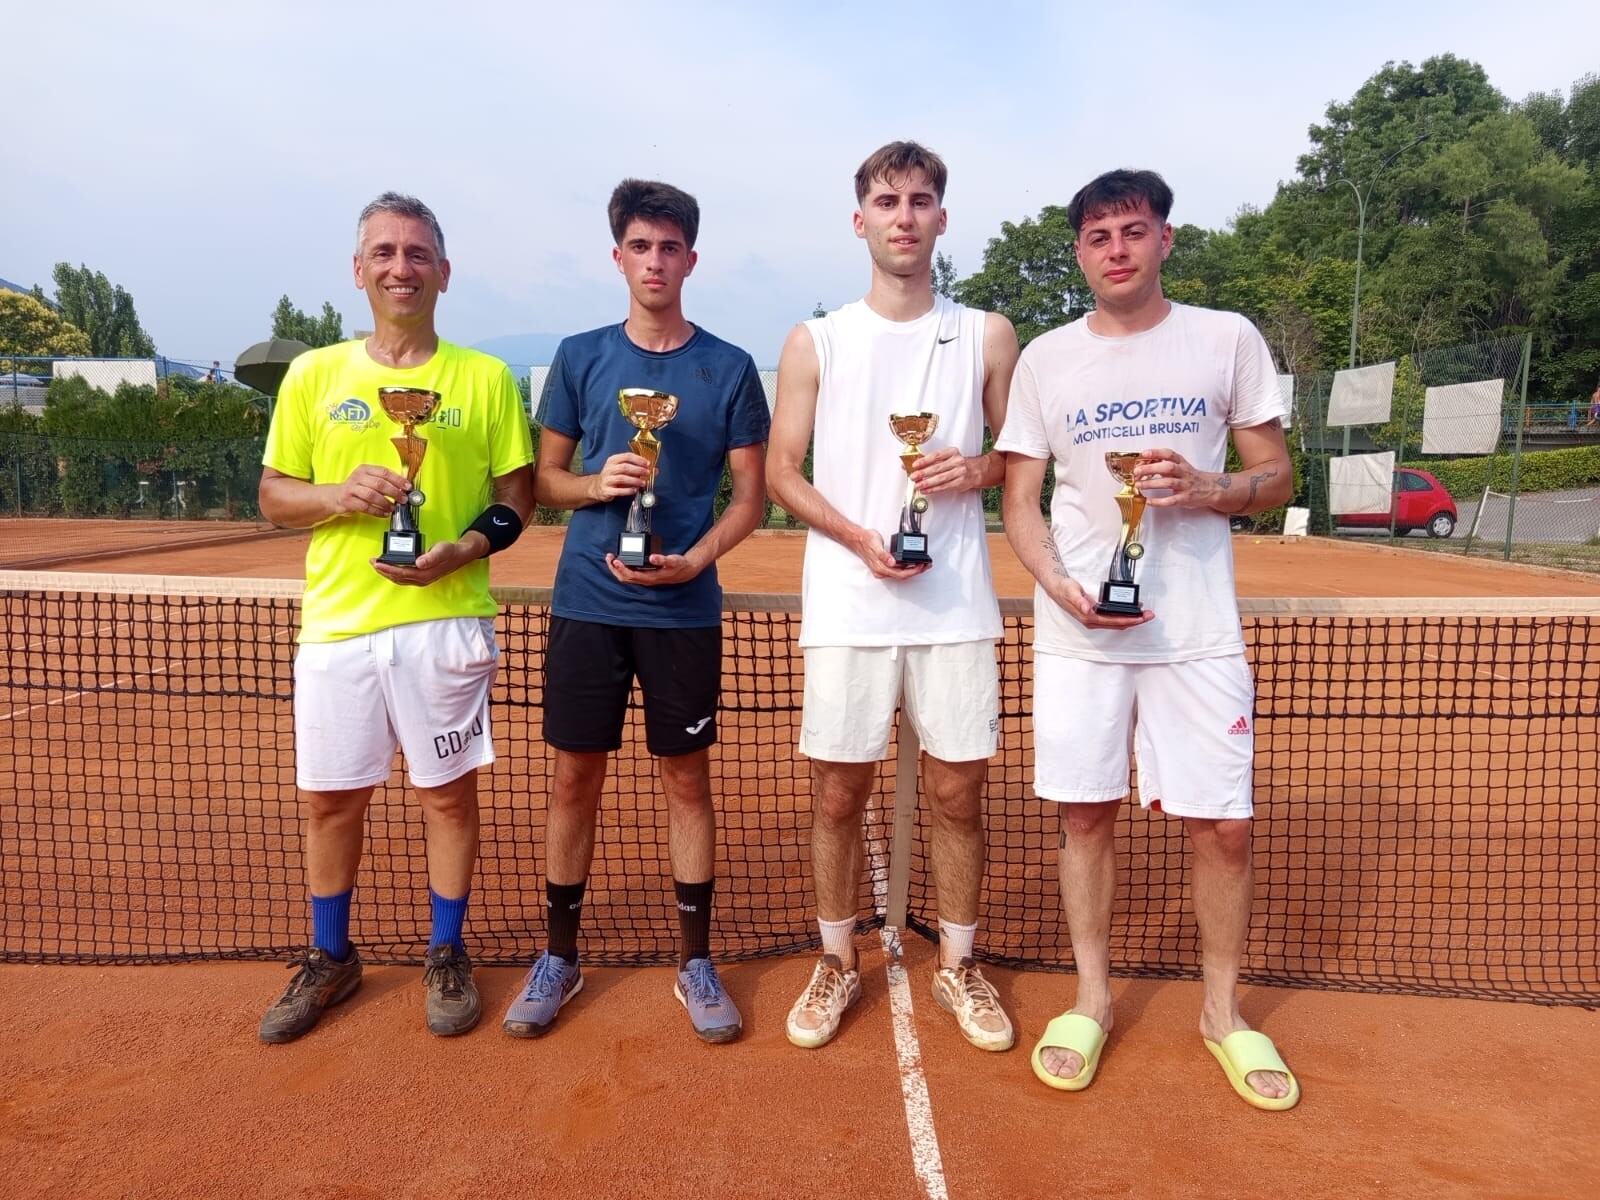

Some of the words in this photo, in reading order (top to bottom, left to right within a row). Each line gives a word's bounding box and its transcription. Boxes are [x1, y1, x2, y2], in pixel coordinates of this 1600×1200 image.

[1066, 408, 1089, 433] LA
[1094, 397, 1207, 424] SPORTIVA
[1073, 424, 1145, 446] MONTICELLI
[1149, 421, 1200, 435] BRUSATI
